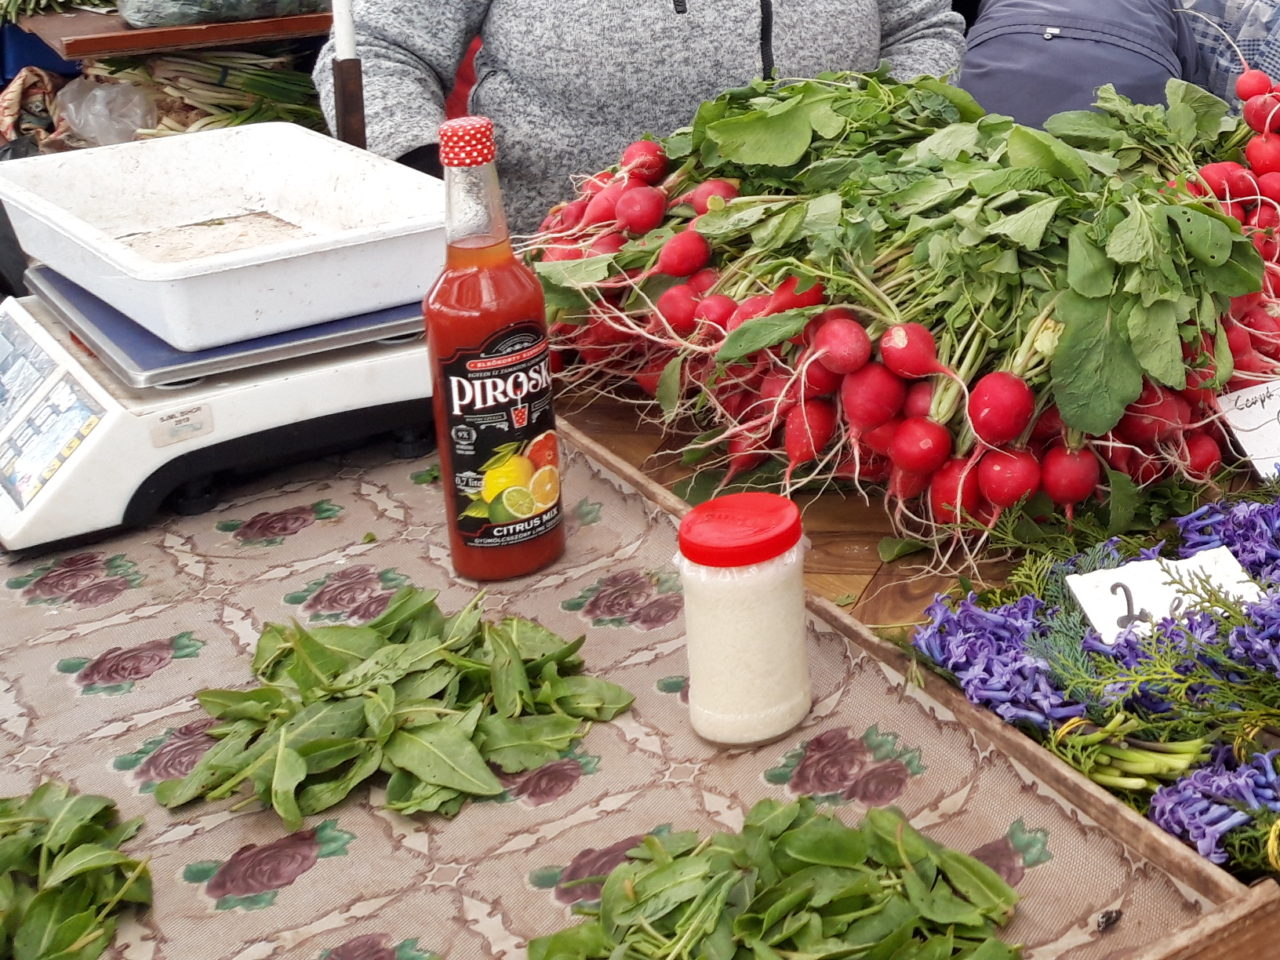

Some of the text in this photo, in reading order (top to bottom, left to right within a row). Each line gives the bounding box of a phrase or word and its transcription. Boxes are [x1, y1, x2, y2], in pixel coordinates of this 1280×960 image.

[493, 518, 540, 536] CITRUS
[542, 507, 559, 522] MIX
[1109, 581, 1152, 629] 2
